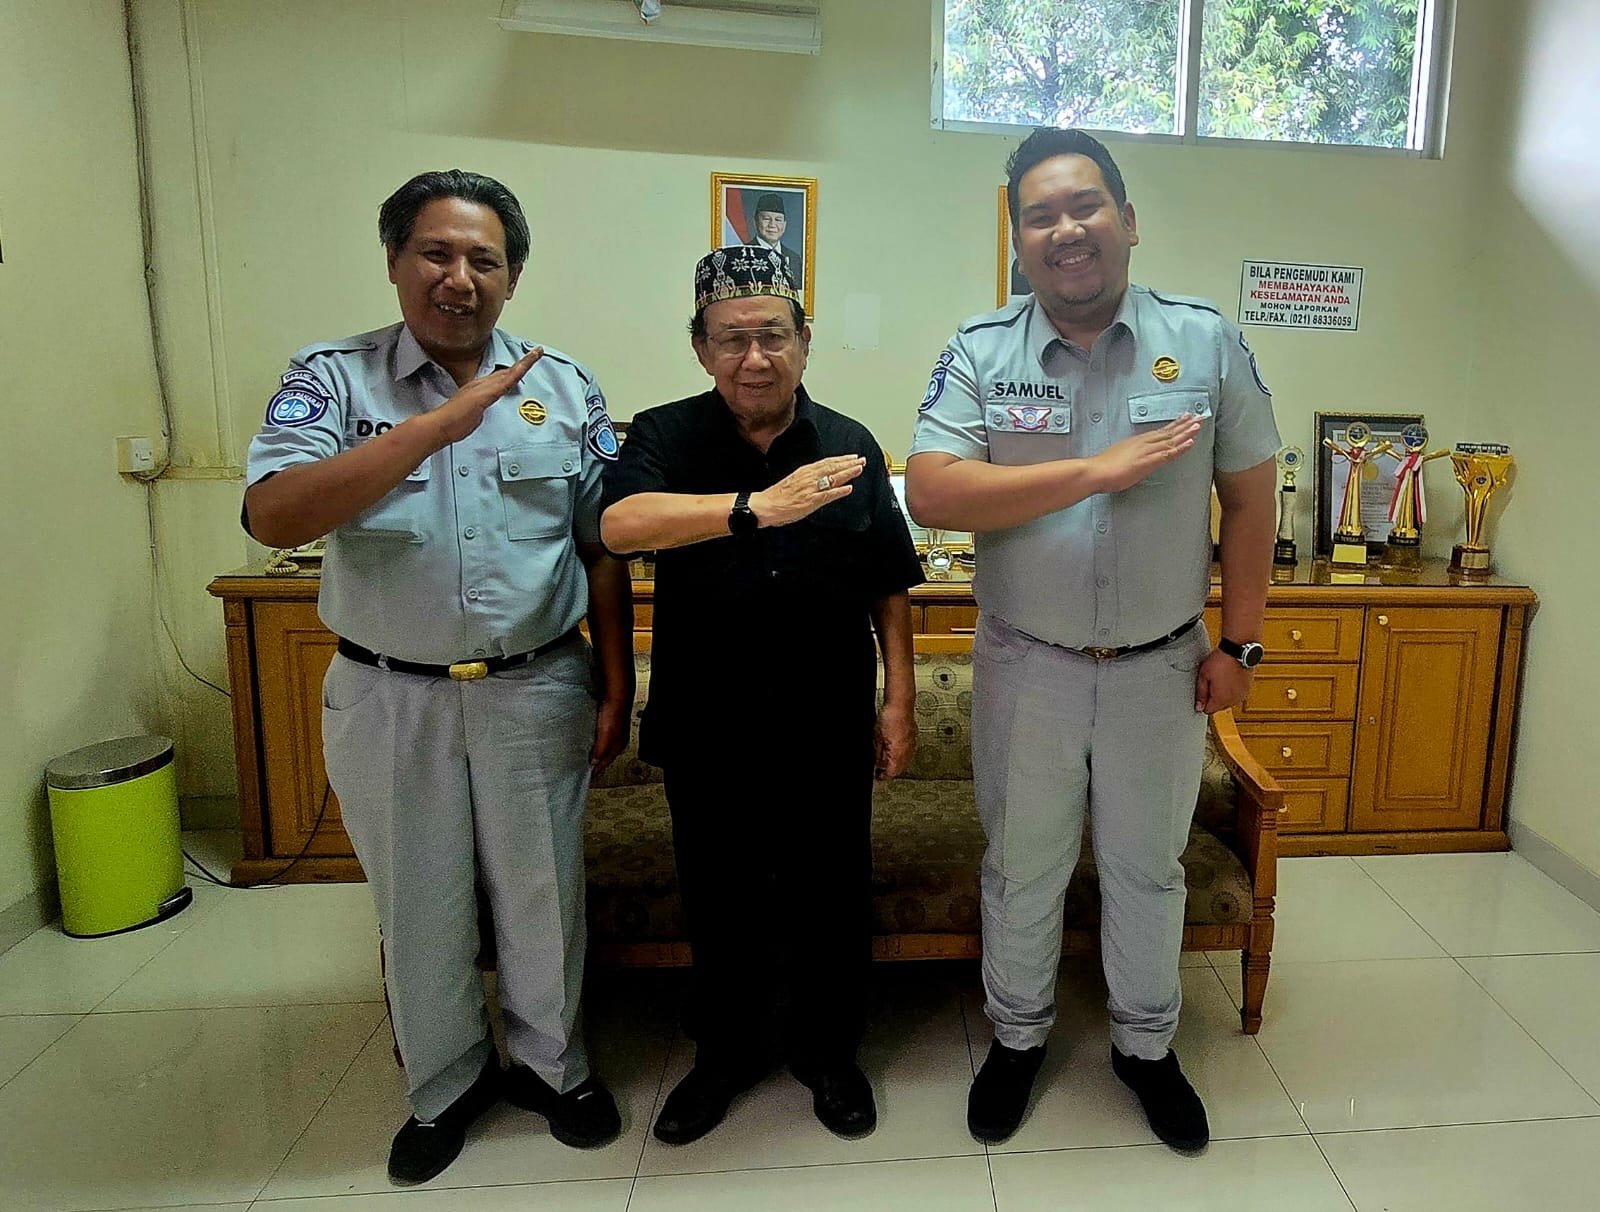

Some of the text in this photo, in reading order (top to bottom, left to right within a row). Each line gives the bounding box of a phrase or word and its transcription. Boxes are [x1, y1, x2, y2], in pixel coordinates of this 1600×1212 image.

[1250, 266, 1355, 284] BILA PENGEMUDI KAMI
[1258, 280, 1344, 294] MEMBAHAYAKAN
[1250, 290, 1350, 305] KESELAMATAN ANDA
[1260, 302, 1339, 313] MOHON LAPORKAN
[1289, 313, 1310, 325] (021)
[1312, 315, 1352, 327] 88336059
[994, 381, 1064, 399] SAMUEL
